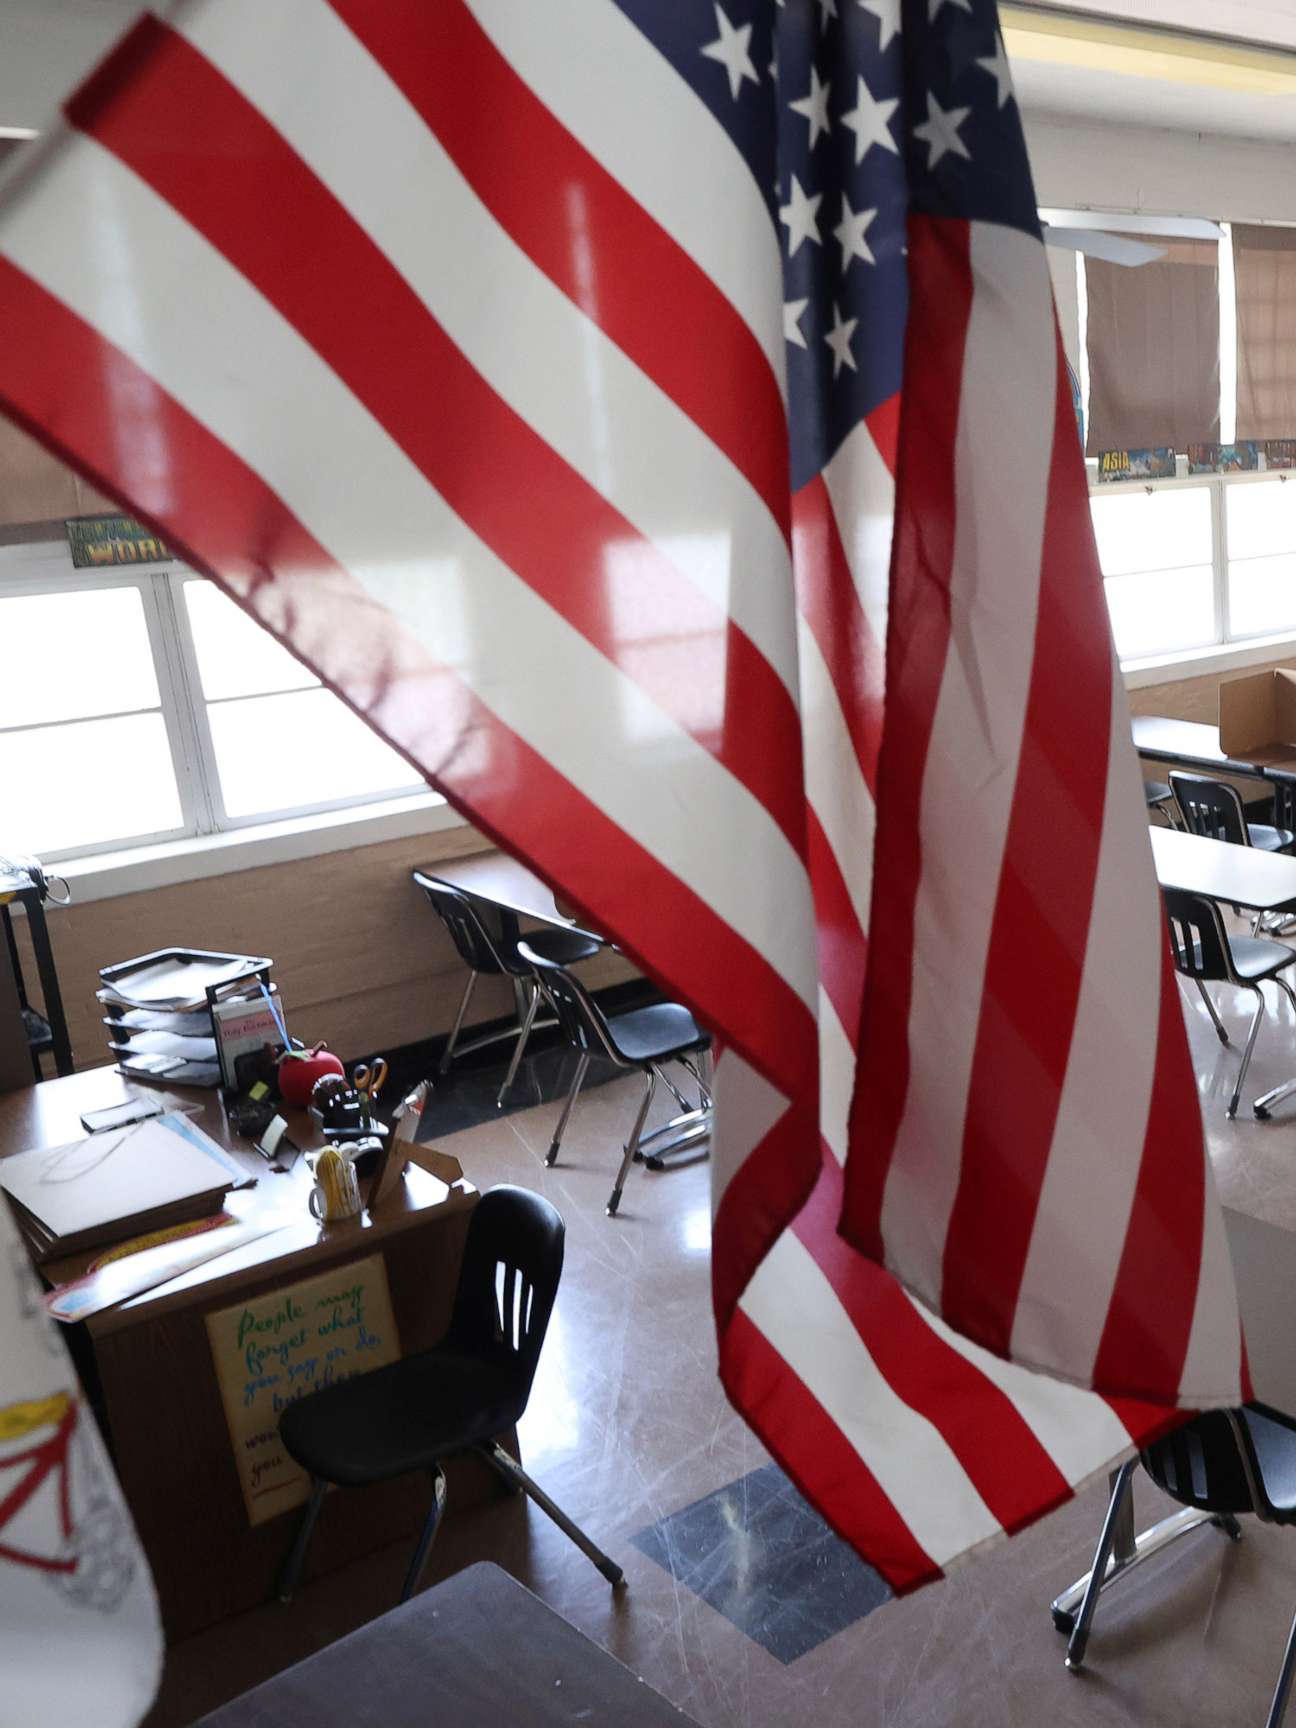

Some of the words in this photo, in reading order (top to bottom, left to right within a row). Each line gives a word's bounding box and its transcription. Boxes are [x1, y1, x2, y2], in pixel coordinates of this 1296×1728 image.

[1103, 451, 1130, 473] ASIA
[237, 1297, 303, 1350] People
[245, 1328, 309, 1375] forget
[318, 1305, 364, 1337] what
[244, 1374, 280, 1408] you
